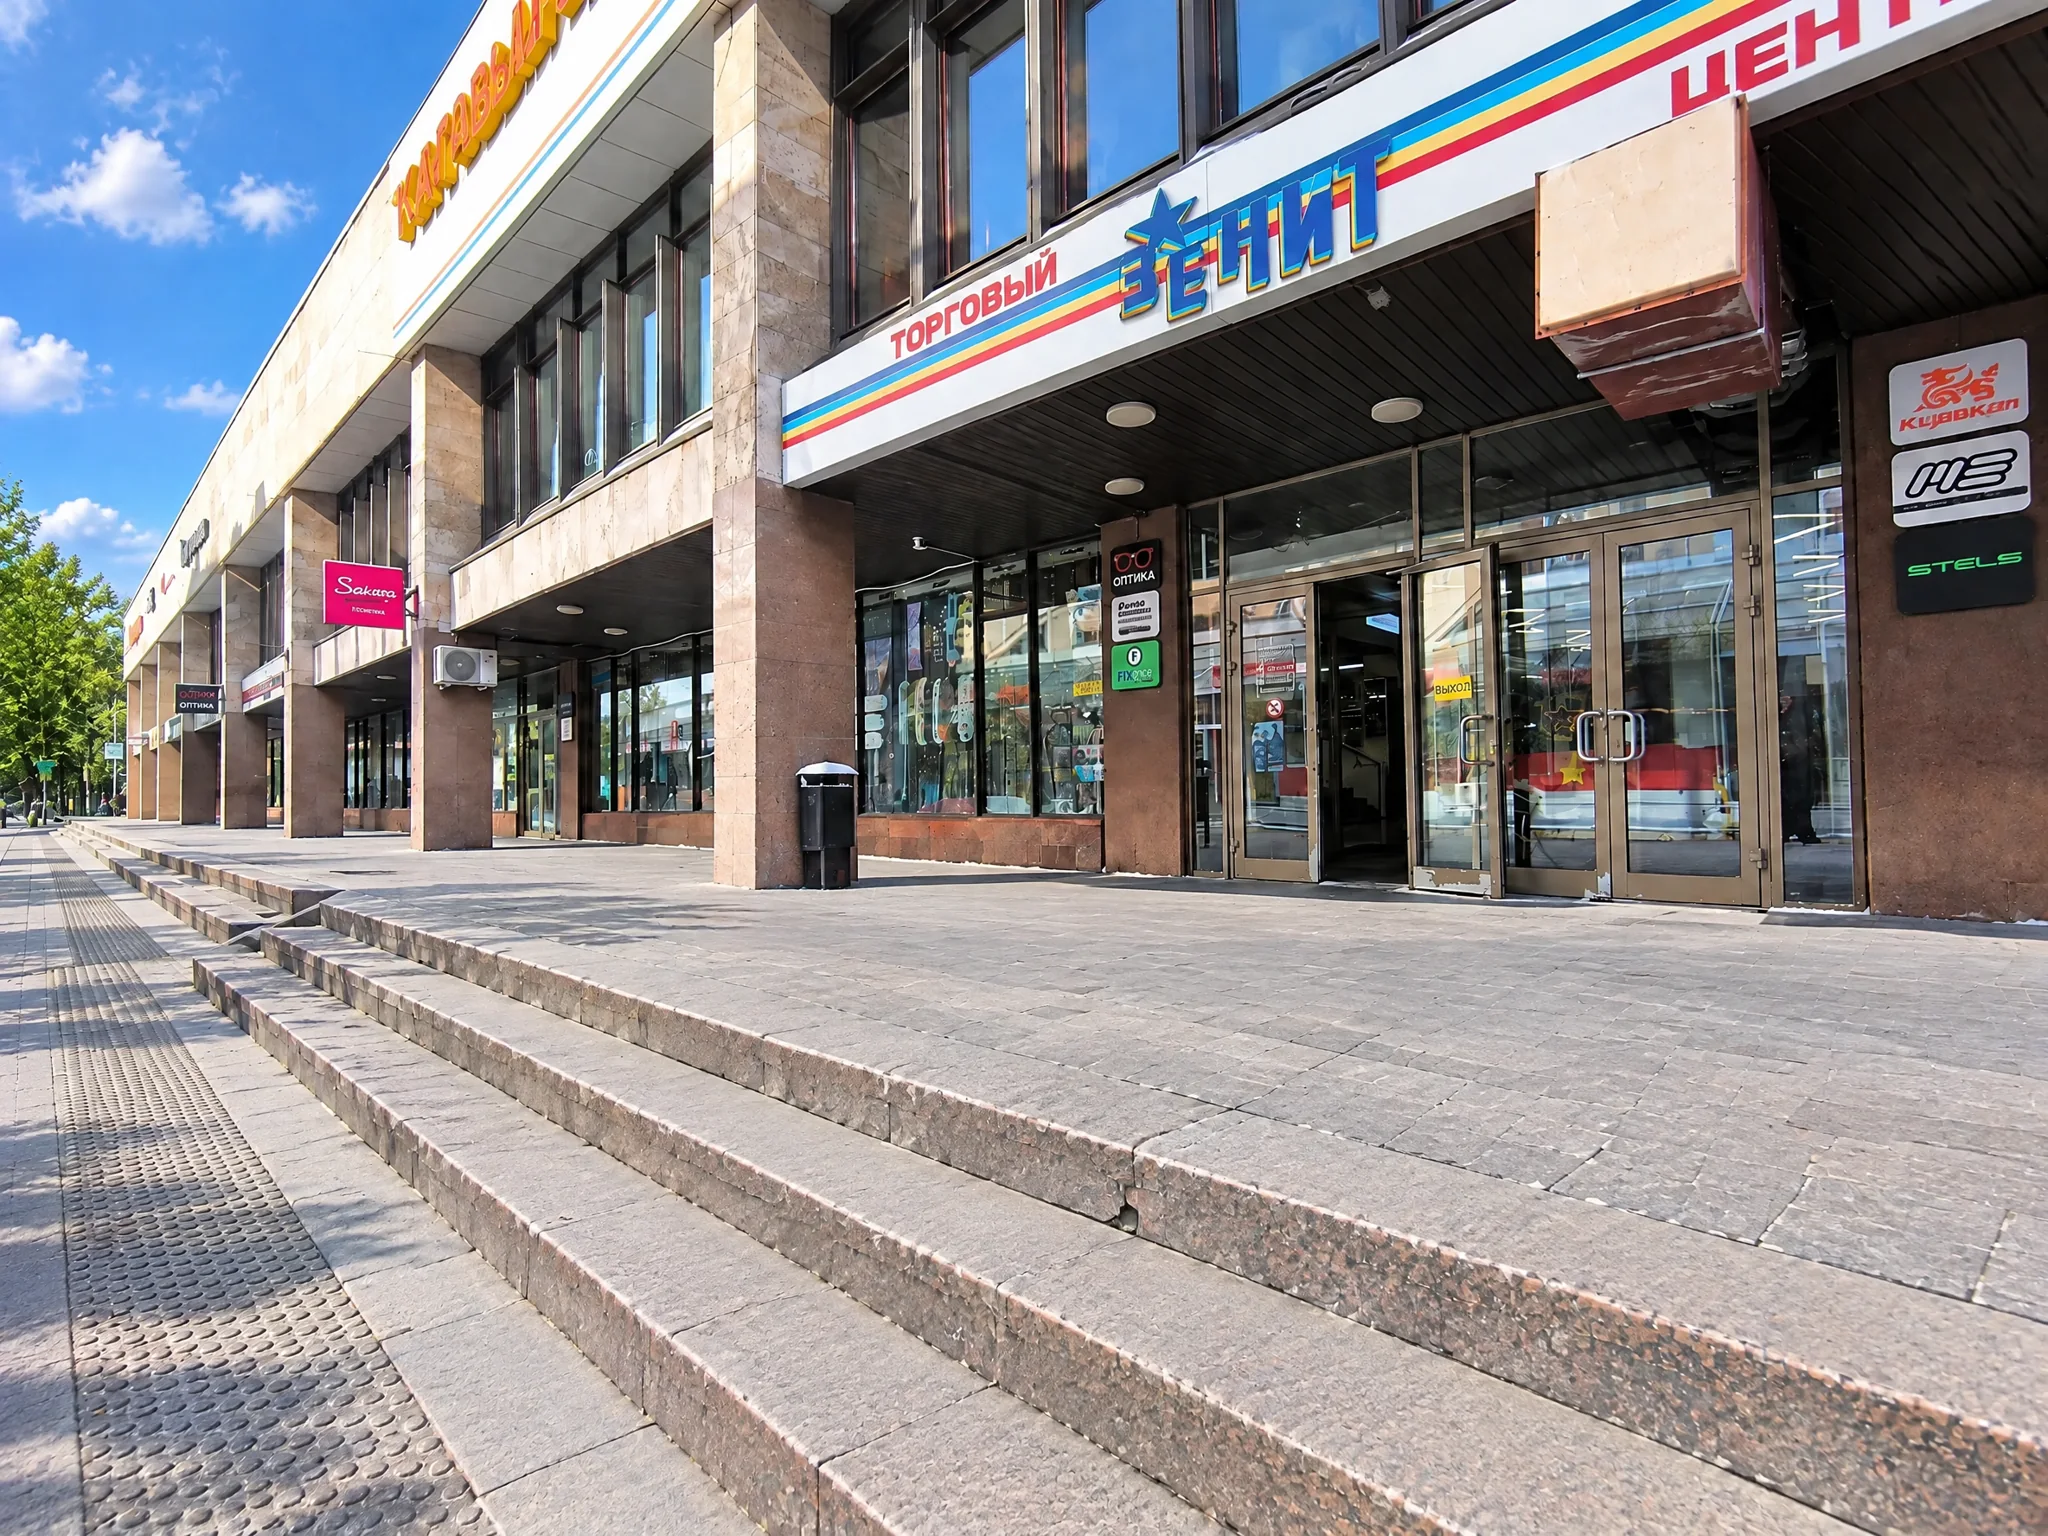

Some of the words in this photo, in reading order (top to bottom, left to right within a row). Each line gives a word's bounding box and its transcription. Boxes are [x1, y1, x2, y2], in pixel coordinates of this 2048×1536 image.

[890, 248, 1058, 360] ТОРГОВЫЙ
[1119, 134, 1392, 322] ЗЕНИТ
[1907, 551, 2023, 577] STELS
[334, 576, 397, 600] Sakara
[1113, 570, 1155, 587] ОПТИКА
